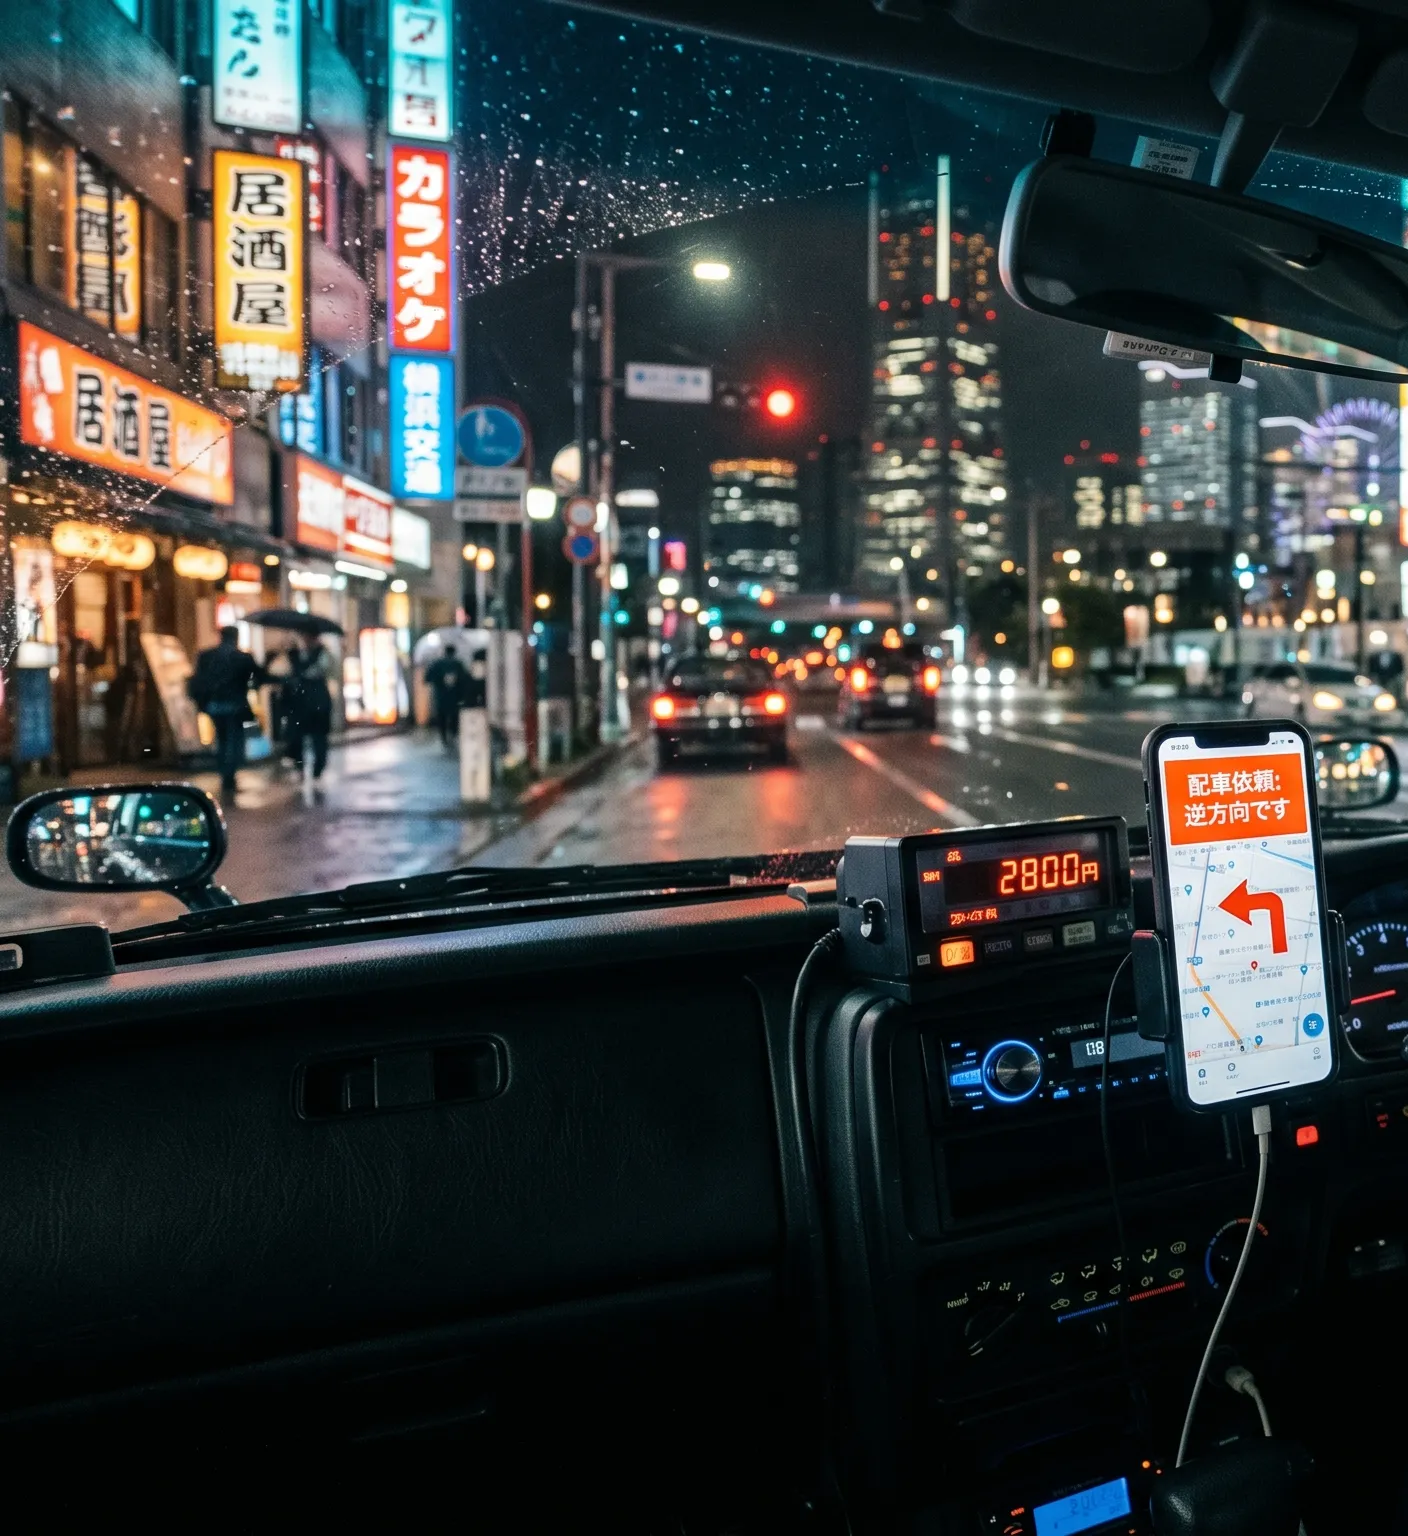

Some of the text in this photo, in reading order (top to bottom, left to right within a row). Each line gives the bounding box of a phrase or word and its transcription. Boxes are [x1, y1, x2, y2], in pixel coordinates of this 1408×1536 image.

[231, 172, 287, 327] 居酒屋
[396, 154, 447, 344] カラオケ
[75, 372, 172, 471] 居酒屋
[1187, 768, 1281, 798] 配車依頼:
[1183, 797, 1291, 828] 逆方向です
[999, 852, 1100, 895] 2800円
[1355, 943, 1365, 957] 3
[1351, 1017, 1362, 1030] 0
